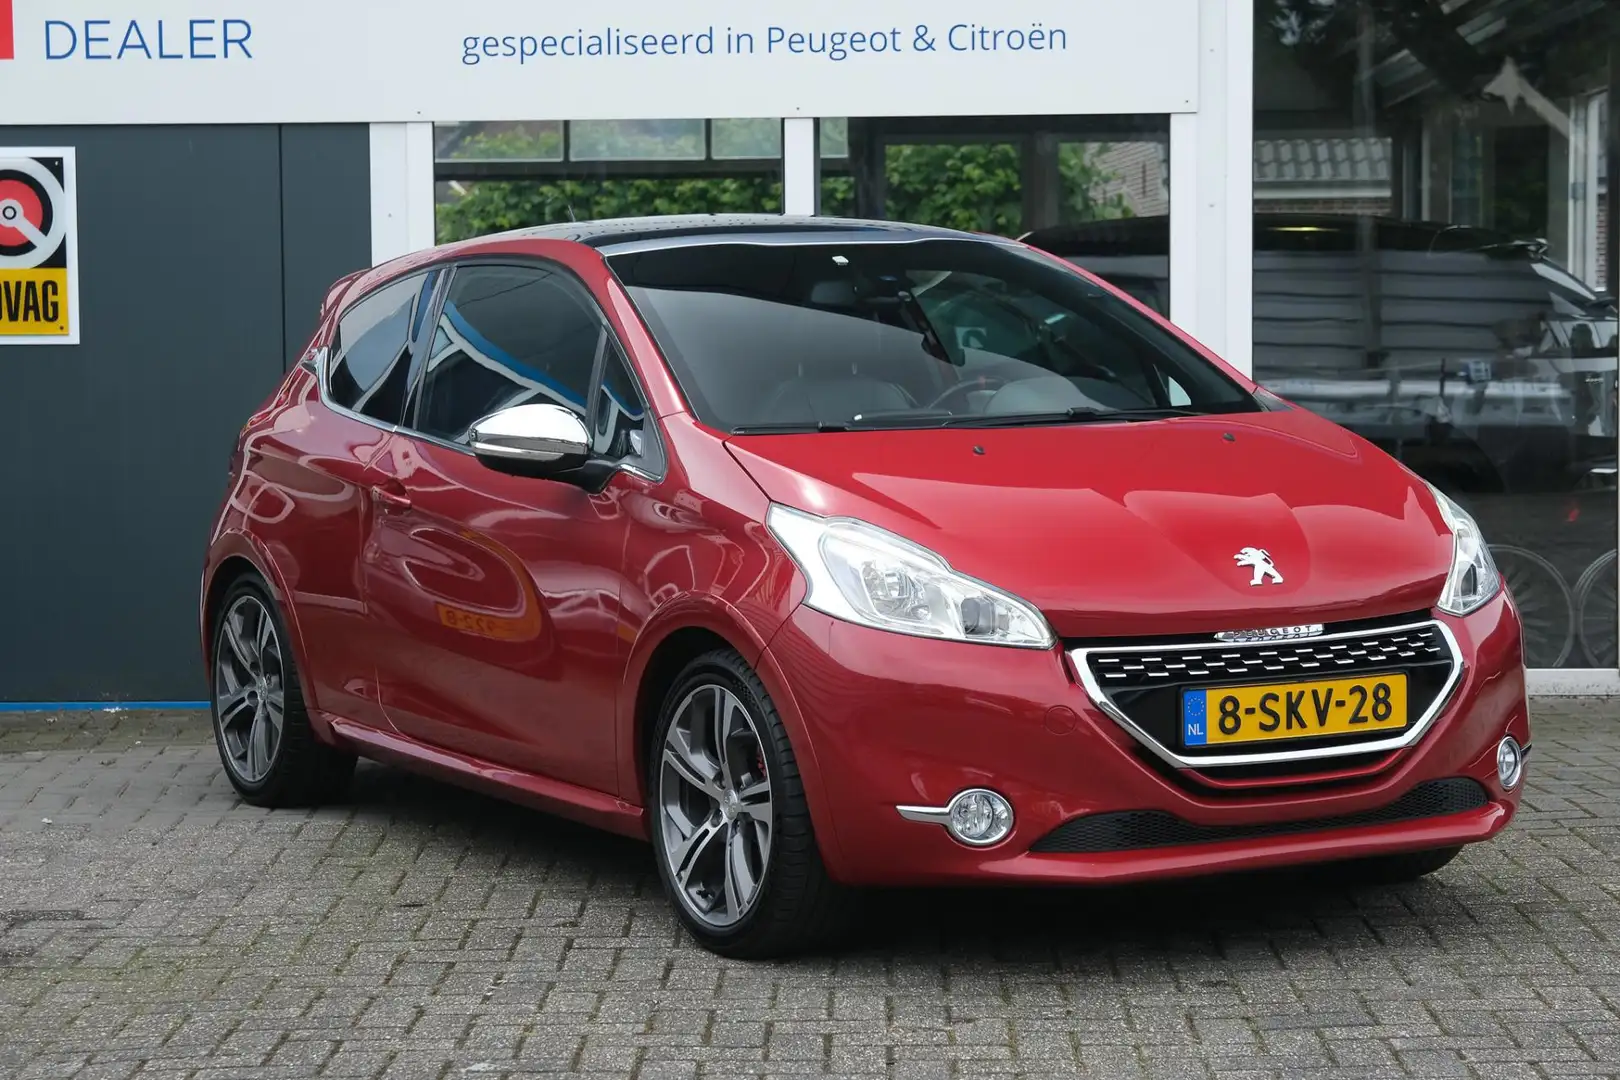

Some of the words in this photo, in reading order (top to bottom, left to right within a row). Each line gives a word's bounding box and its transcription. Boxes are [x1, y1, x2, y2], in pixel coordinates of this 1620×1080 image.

[45, 19, 253, 60] DEALER
[462, 26, 714, 65] gespecialiseerd
[727, 27, 754, 55] in
[768, 25, 901, 61] Peugeot
[913, 24, 937, 53] &
[948, 22, 1067, 52] Citroën
[0, 280, 59, 322] VAG
[1233, 625, 1313, 640] PEUGEOT
[1218, 682, 1392, 735] 8-SKV-28
[1187, 723, 1204, 736] NL
